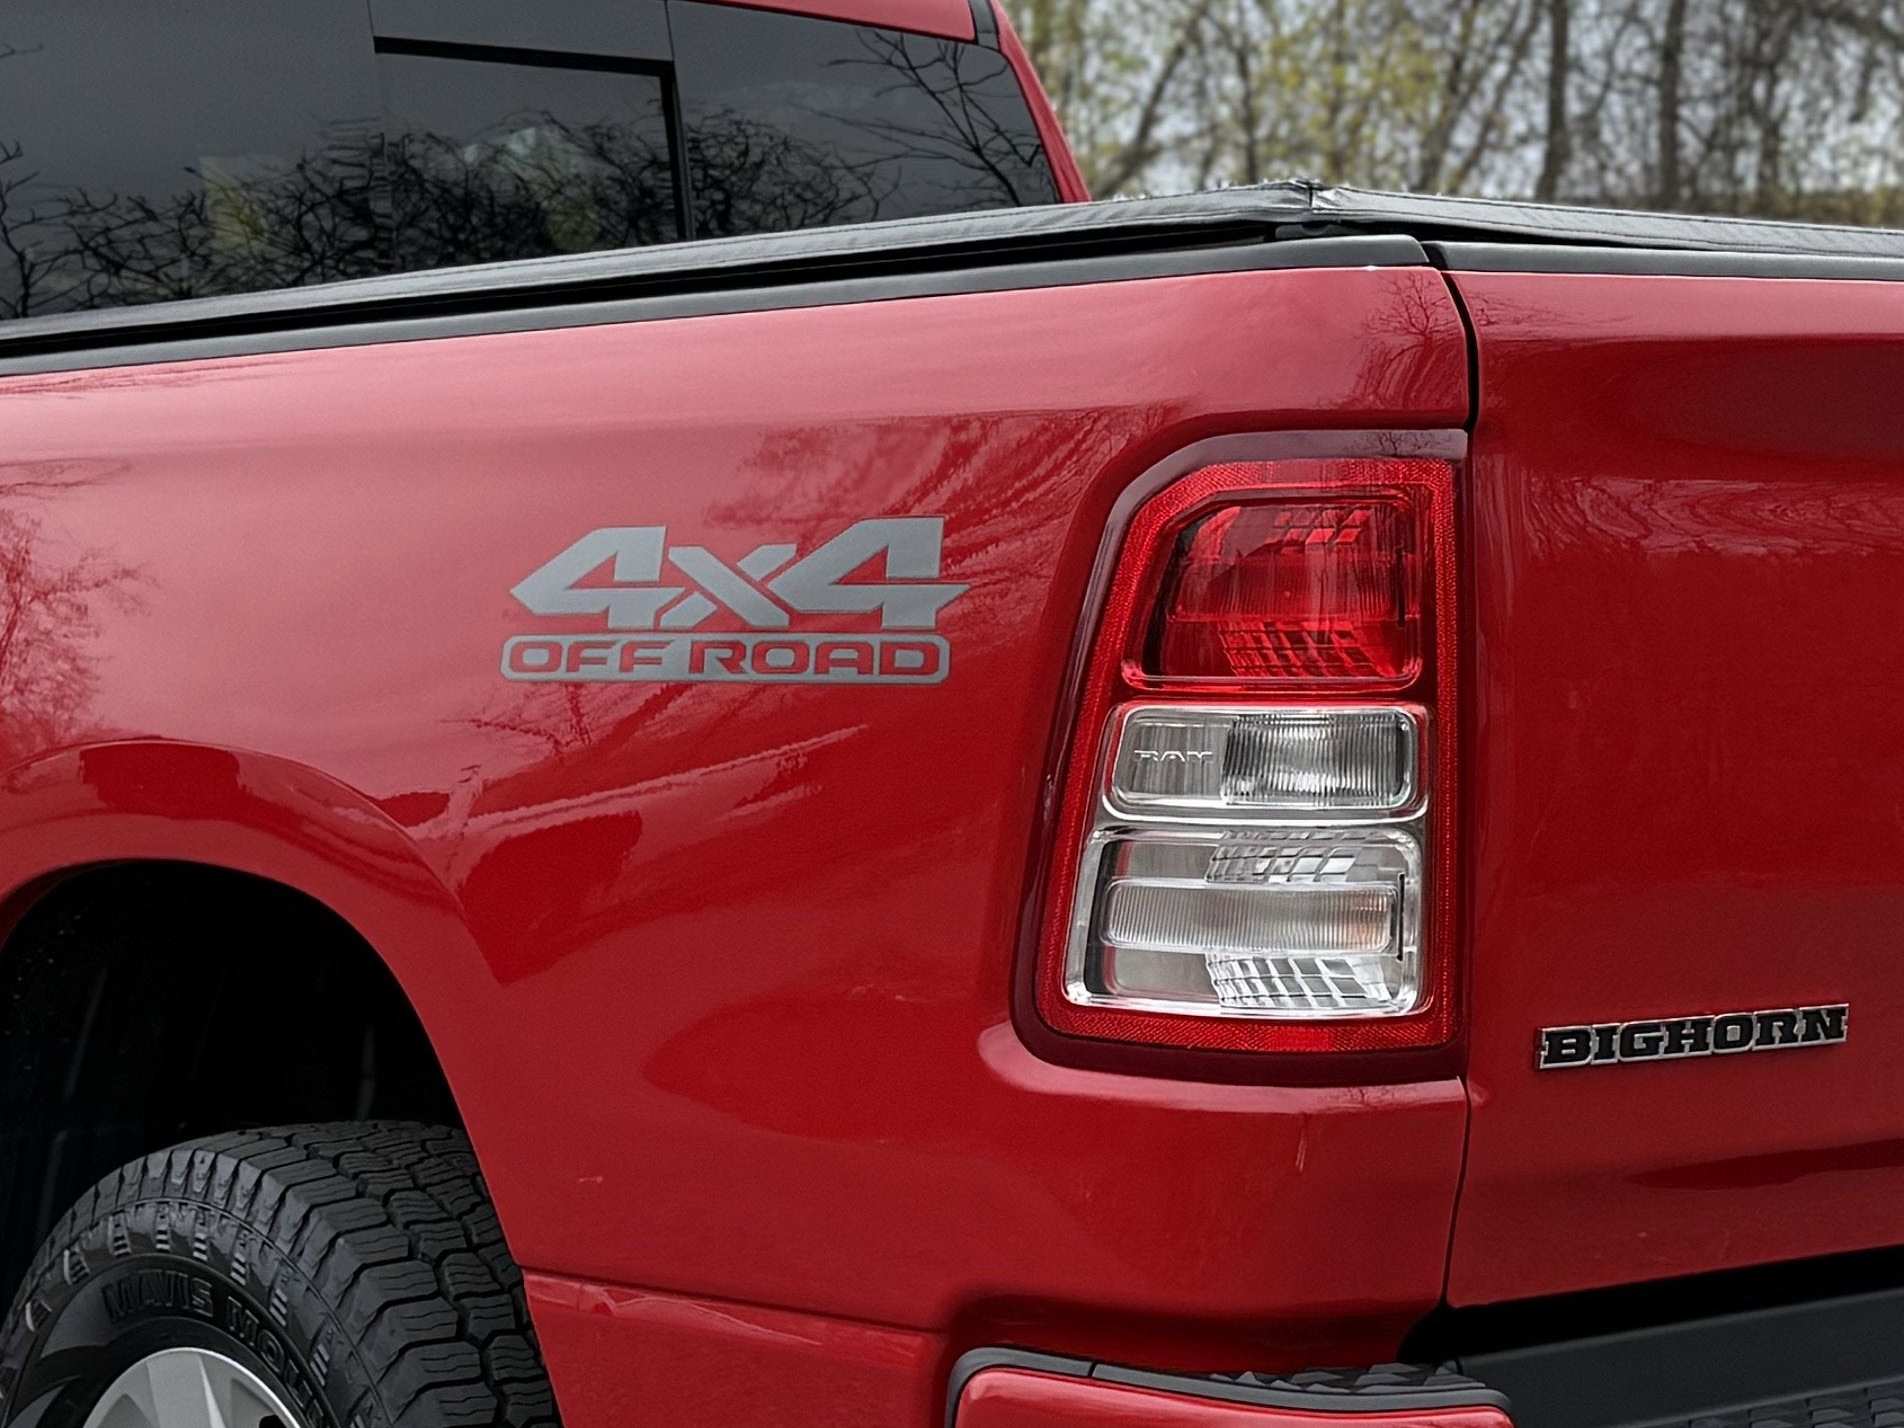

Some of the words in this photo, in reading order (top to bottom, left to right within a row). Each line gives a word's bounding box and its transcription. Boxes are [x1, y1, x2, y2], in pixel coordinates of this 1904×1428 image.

[510, 640, 675, 673] OFF
[689, 640, 940, 676] ROAD
[1535, 1002, 1850, 1070] BIGHORN
[101, 1270, 214, 1323] MAVIS
